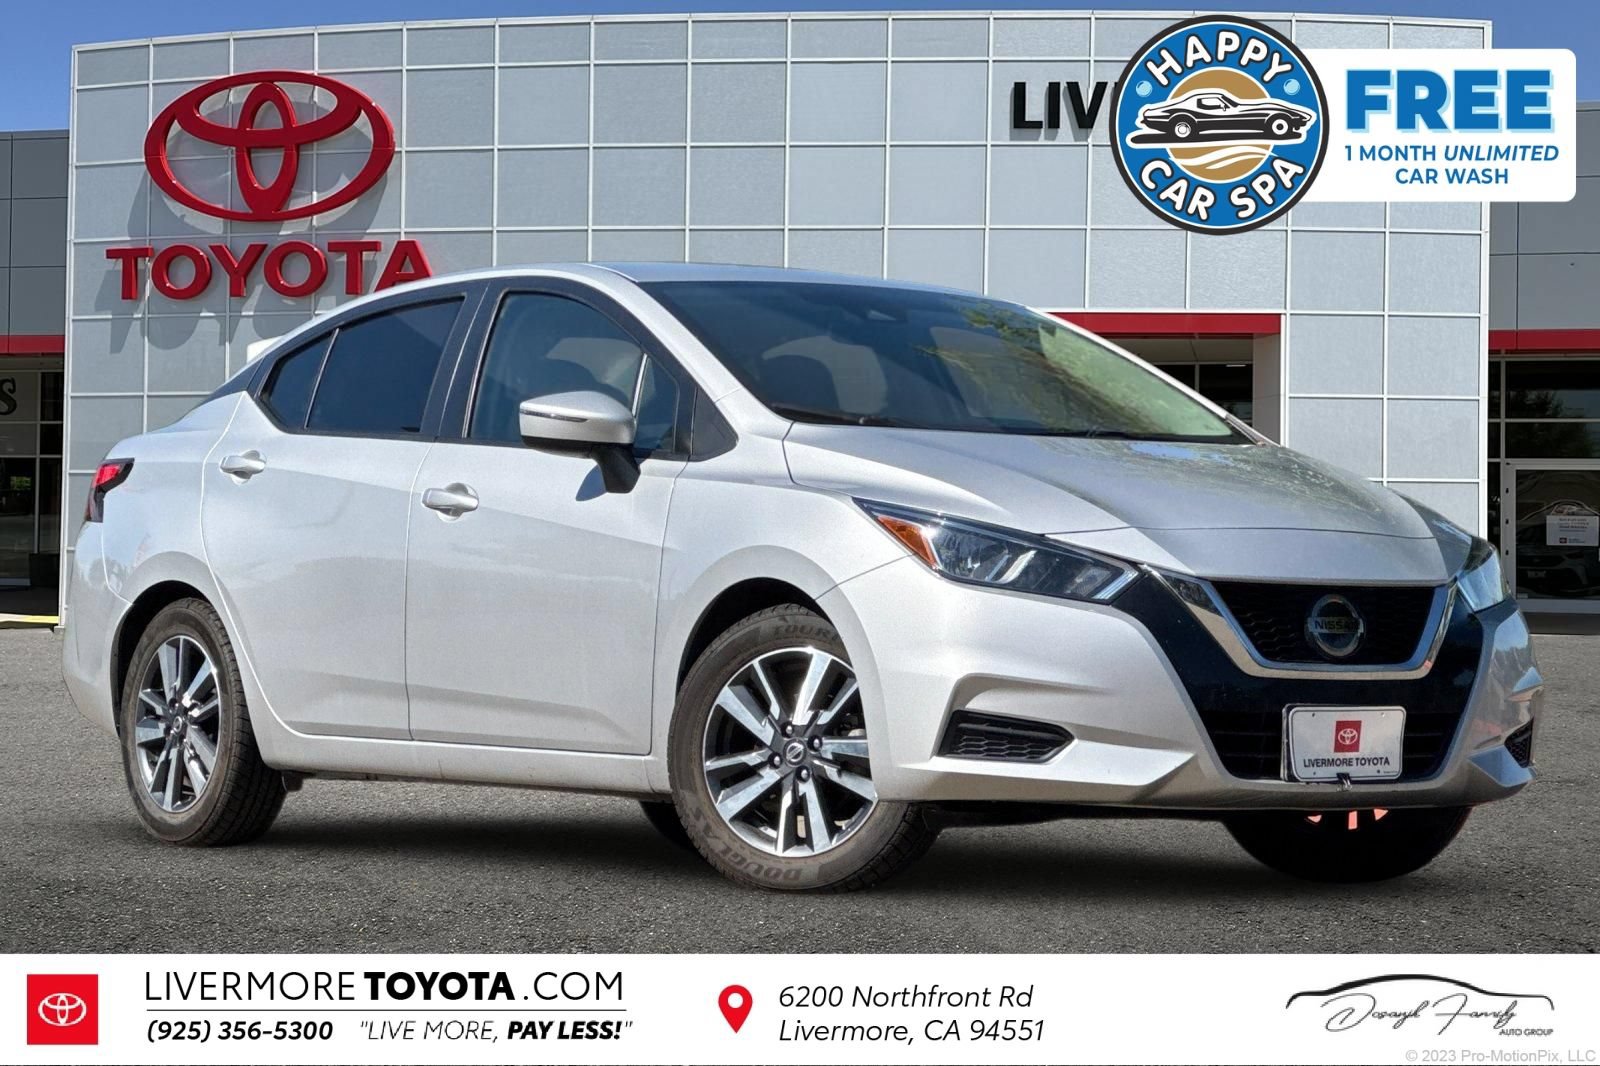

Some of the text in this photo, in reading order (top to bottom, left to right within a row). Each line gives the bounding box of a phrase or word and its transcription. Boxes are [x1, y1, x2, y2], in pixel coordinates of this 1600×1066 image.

[1013, 81, 1112, 131] LIV
[106, 239, 432, 299] TOYOTA
[1314, 620, 1359, 630] NISS
[1303, 757, 1390, 768] LIVERMORE TOYOTA
